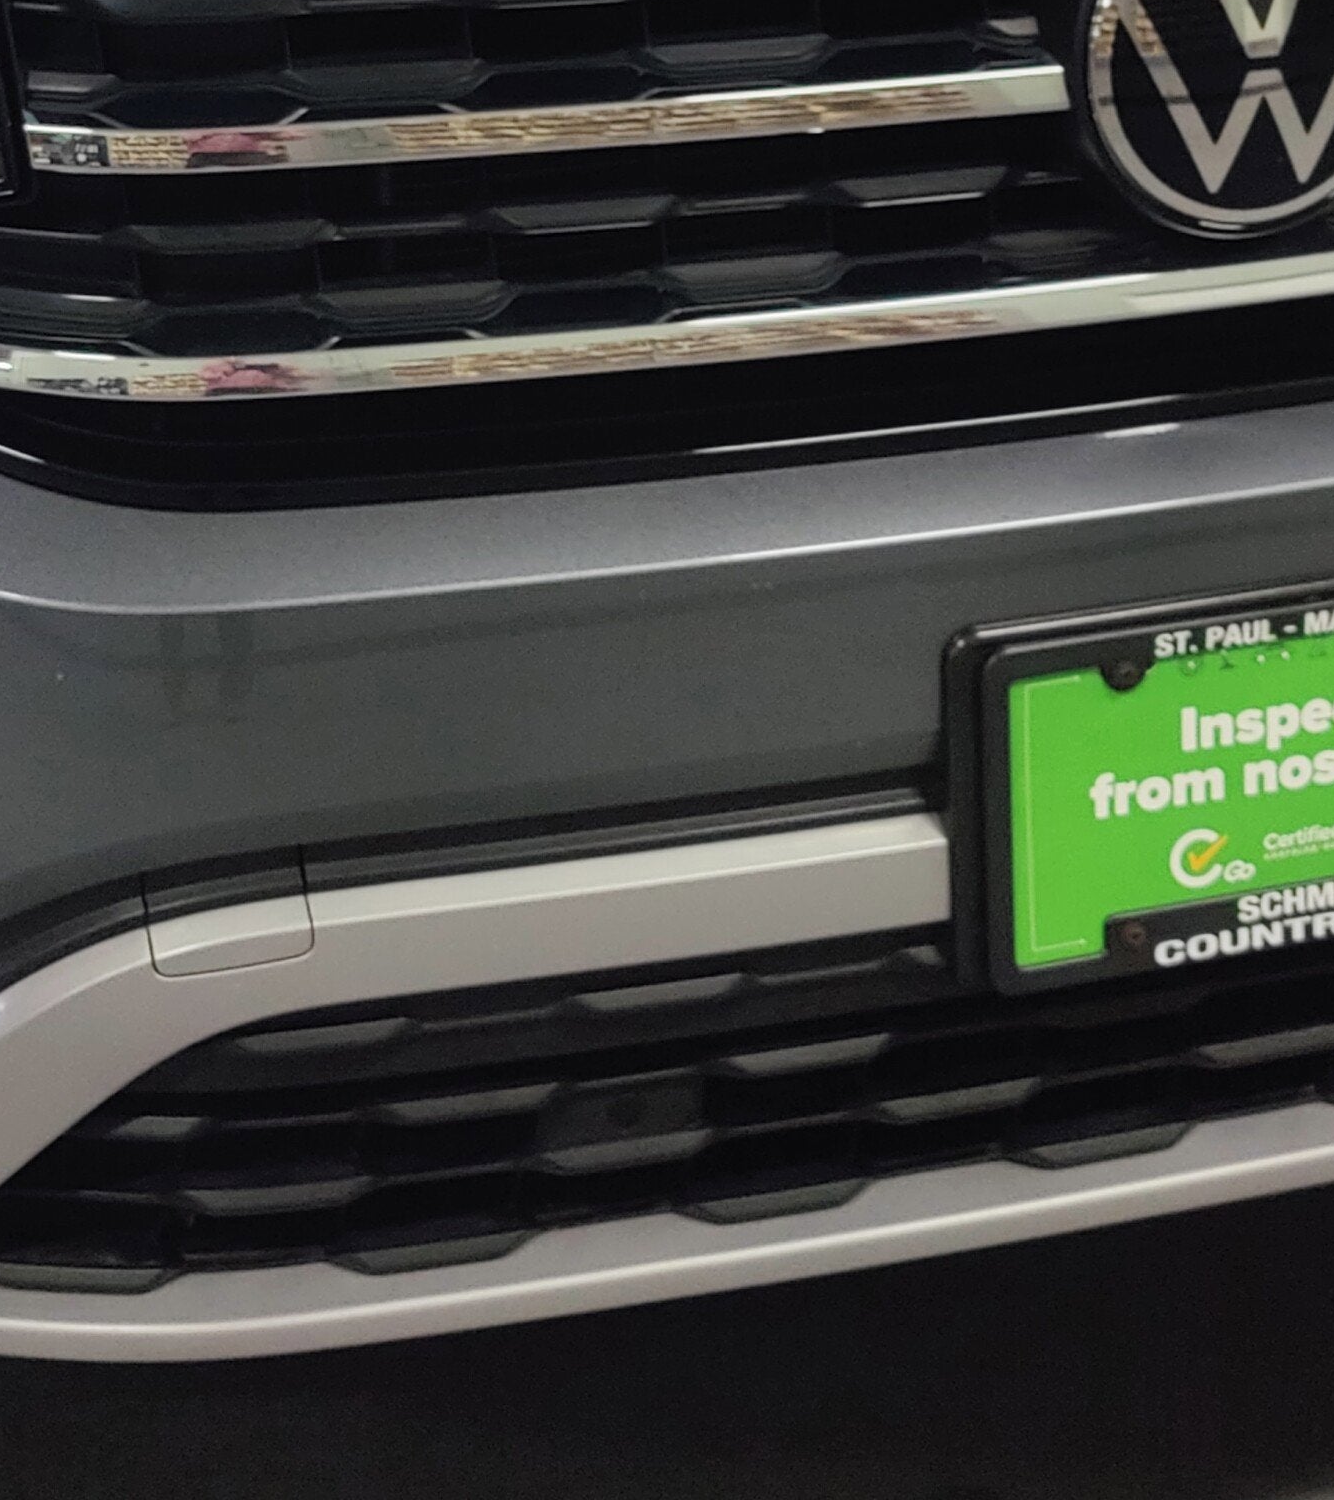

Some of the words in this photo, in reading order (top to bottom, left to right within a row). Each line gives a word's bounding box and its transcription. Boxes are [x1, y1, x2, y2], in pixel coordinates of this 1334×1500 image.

[1154, 631, 1199, 659] ST.
[1205, 618, 1278, 650] PAUL
[1090, 767, 1227, 820] from
